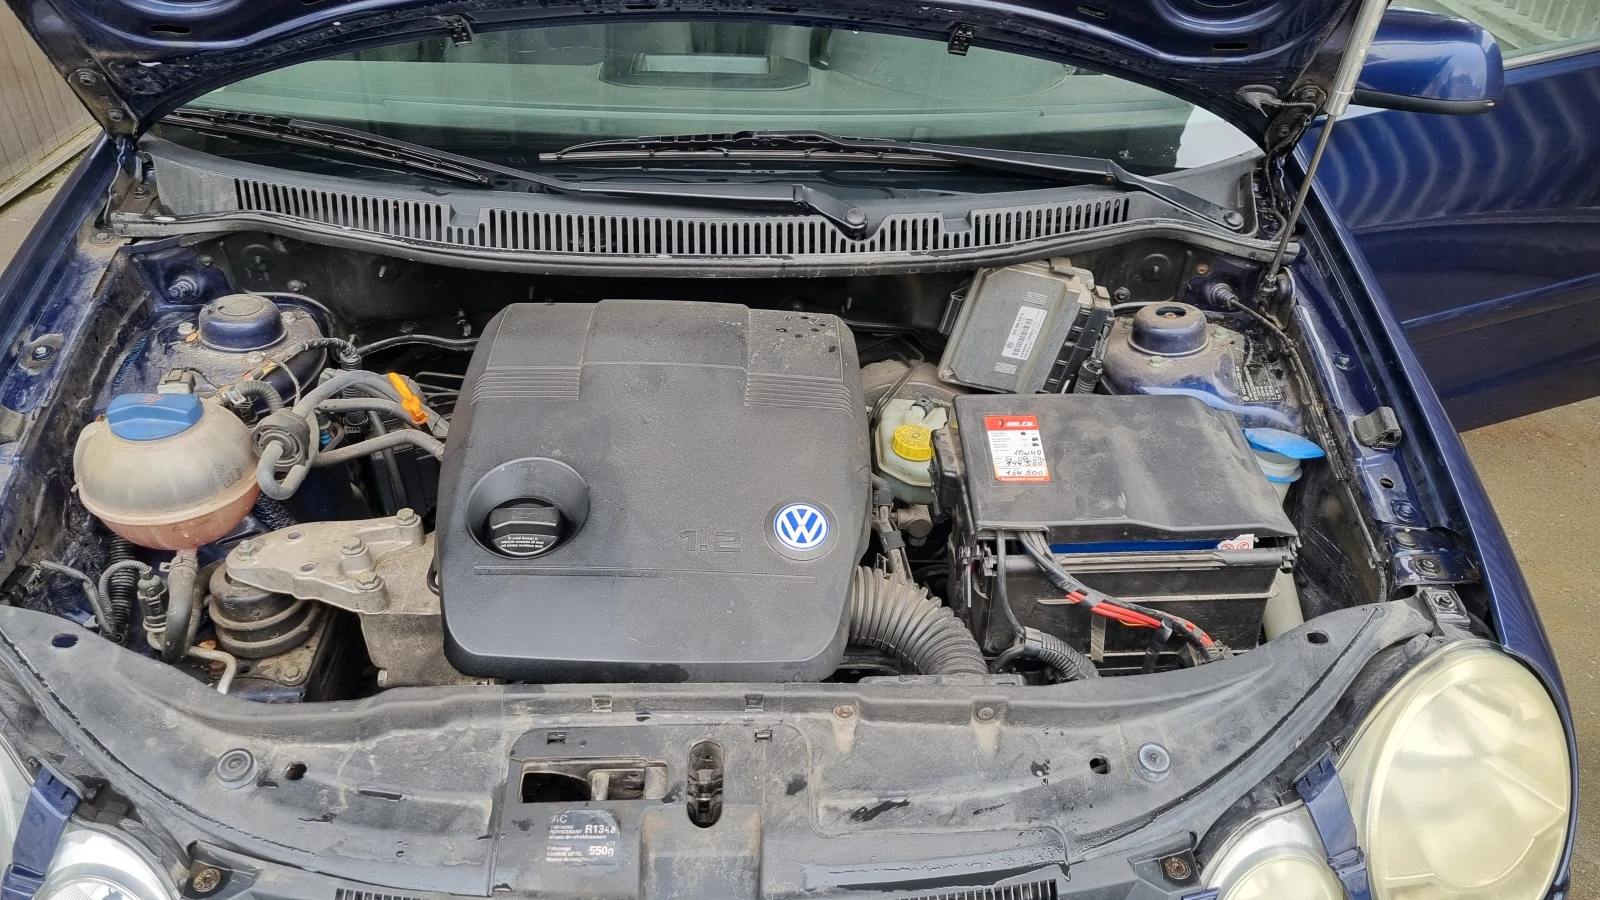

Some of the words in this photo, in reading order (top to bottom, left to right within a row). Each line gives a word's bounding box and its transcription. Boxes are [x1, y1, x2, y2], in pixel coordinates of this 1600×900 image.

[679, 530, 742, 552] 1.2
[551, 814, 568, 823] AC
[589, 845, 614, 857] 550g
